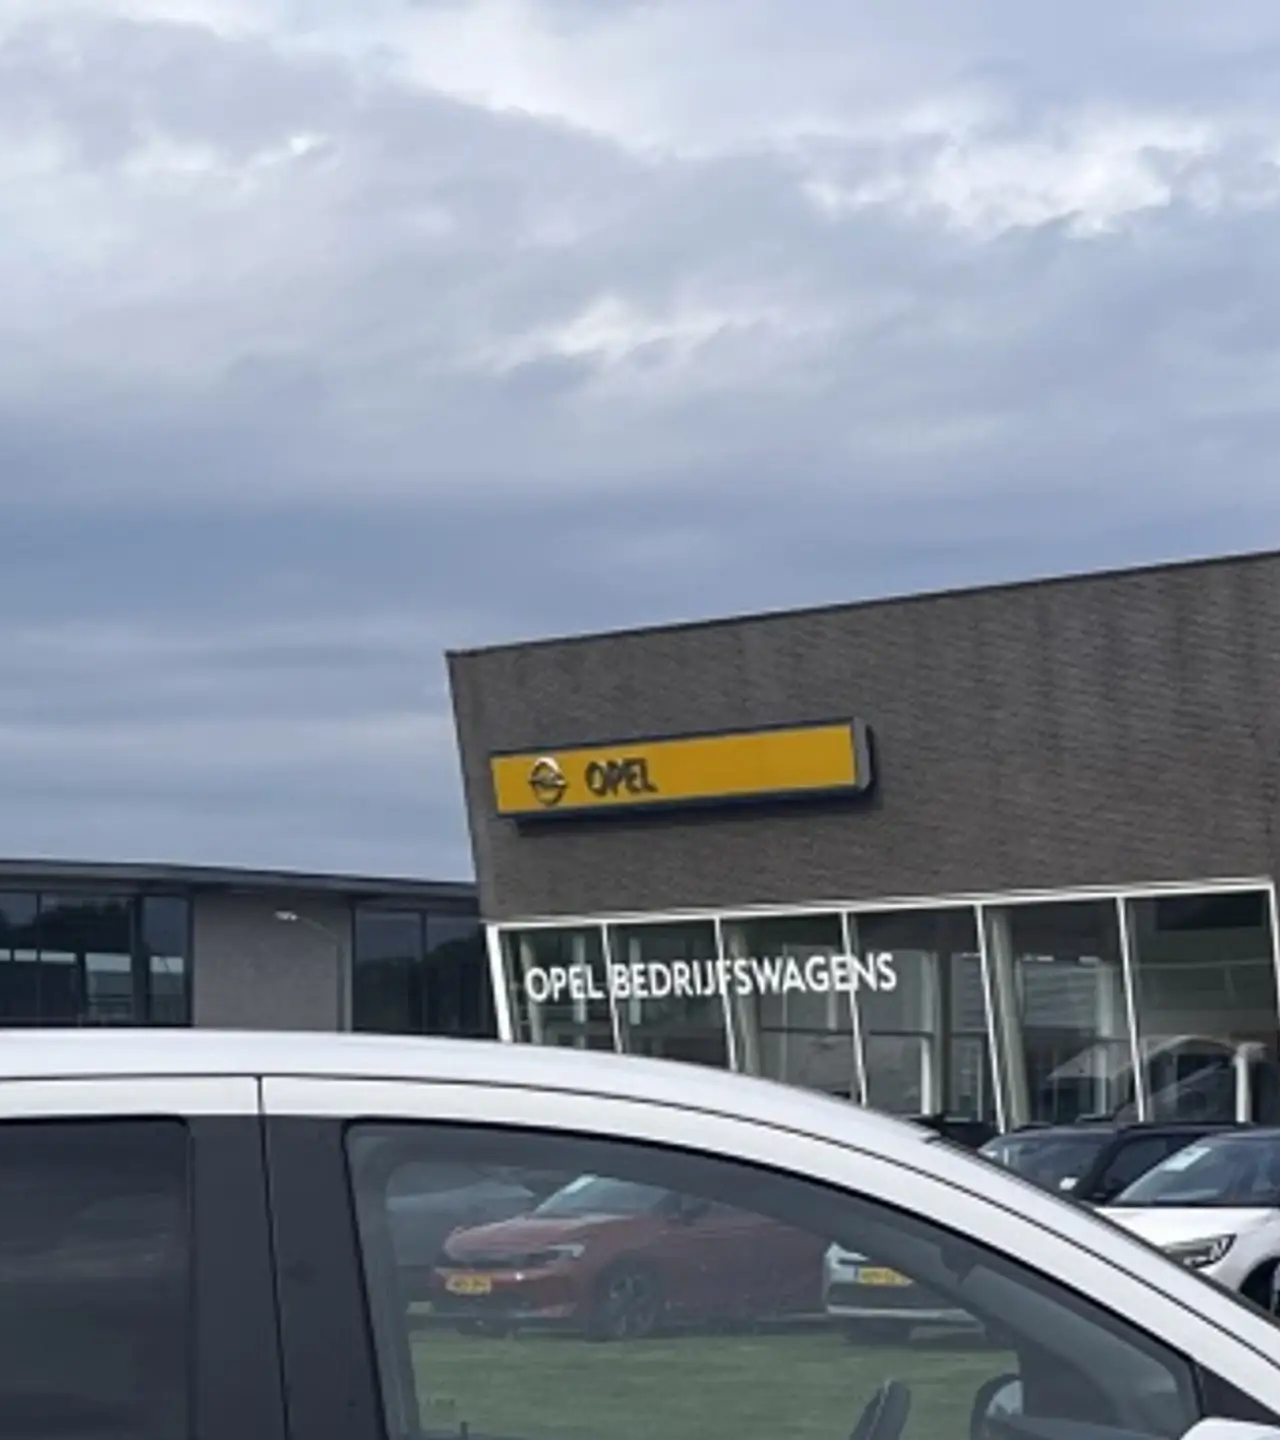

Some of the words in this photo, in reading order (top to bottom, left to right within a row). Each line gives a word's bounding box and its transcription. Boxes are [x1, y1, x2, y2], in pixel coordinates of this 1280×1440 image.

[585, 758, 658, 796] OPEL
[524, 963, 606, 1001] OPEL
[613, 952, 898, 999] BEDRIJFSWAGENS
